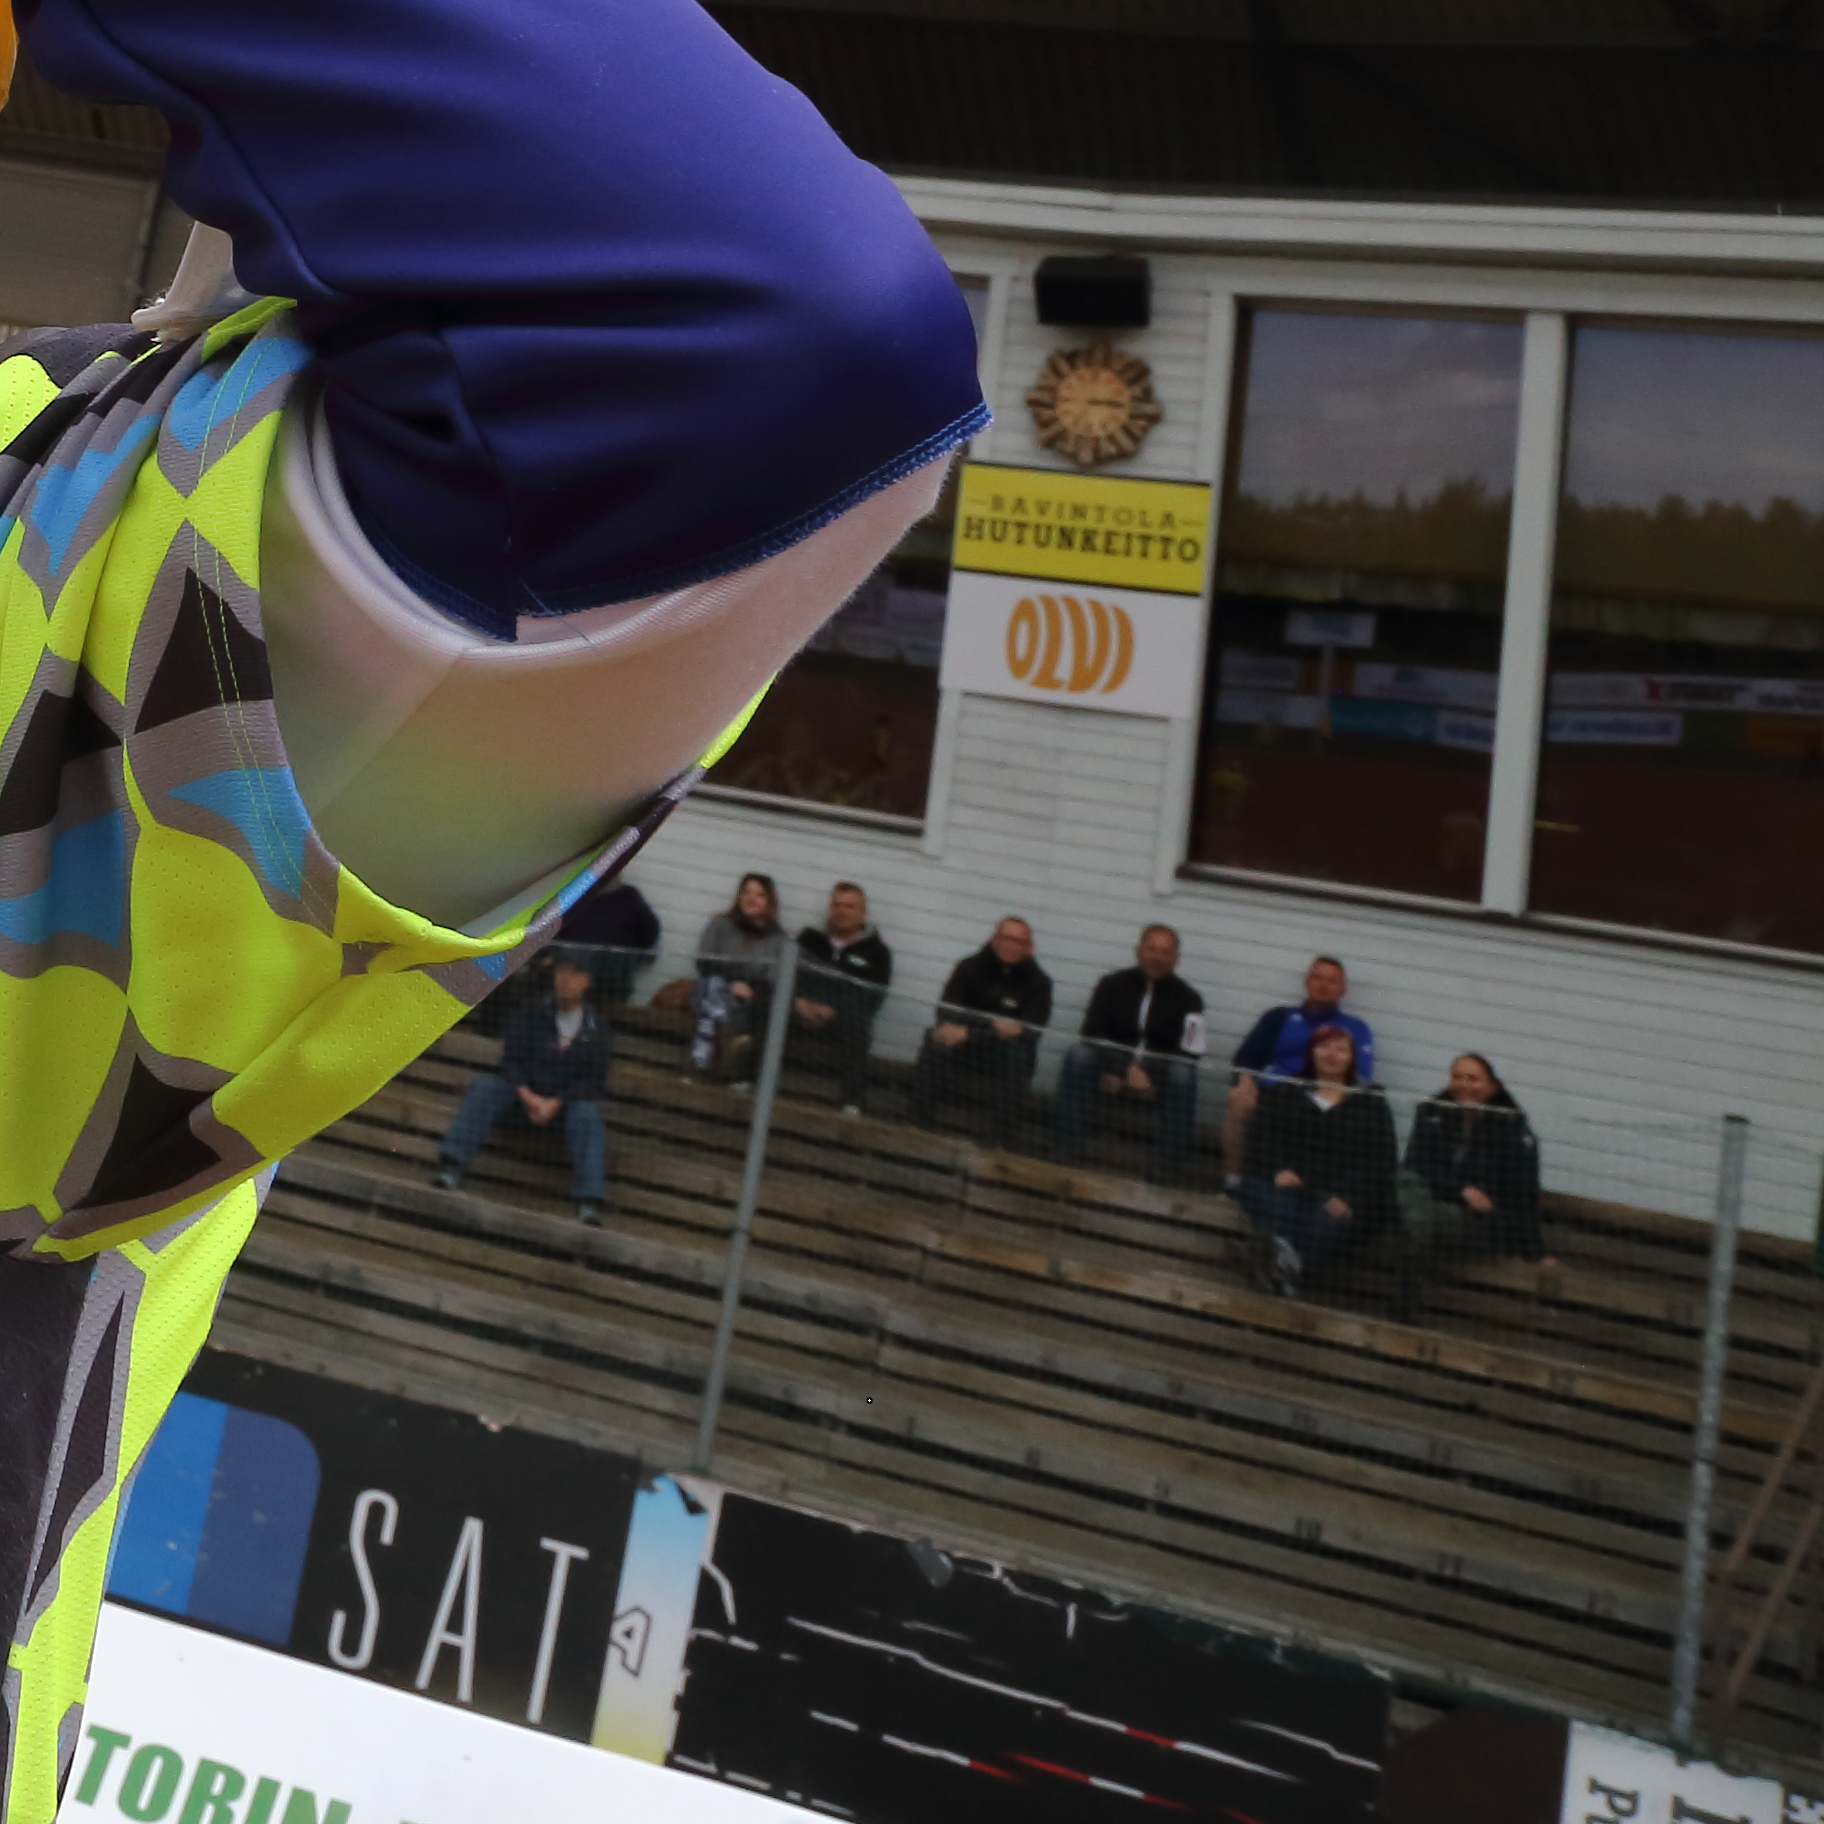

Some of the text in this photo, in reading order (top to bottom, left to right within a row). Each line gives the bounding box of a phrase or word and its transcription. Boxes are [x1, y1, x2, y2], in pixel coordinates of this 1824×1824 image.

[990, 493, 1178, 529] RAVINTOLA
[962, 514, 1201, 564] HUTUNKEITTO
[1005, 593, 1136, 694] OLVI
